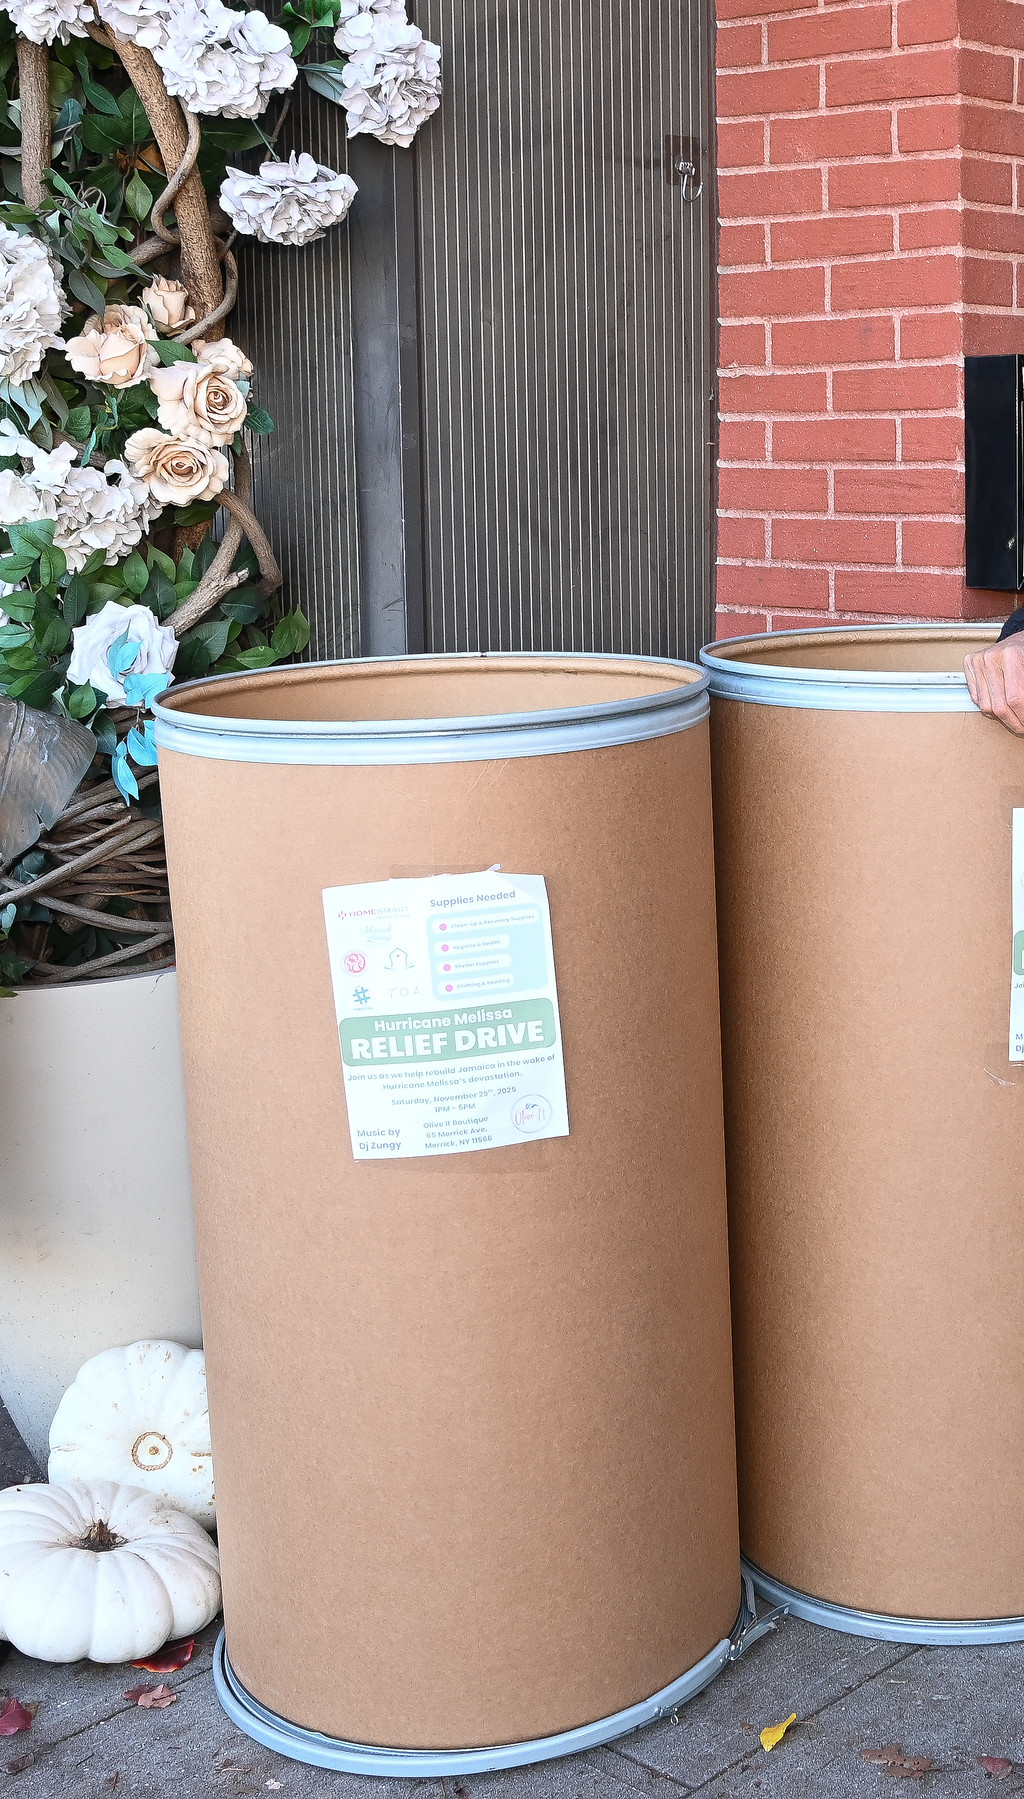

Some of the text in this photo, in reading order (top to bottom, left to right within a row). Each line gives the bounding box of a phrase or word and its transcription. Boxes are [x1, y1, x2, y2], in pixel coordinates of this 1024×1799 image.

[430, 890, 516, 908] Supplies Needed
[349, 906, 409, 917] HOMESMART
[374, 1008, 513, 1032] Hurricane Melissa
[350, 1020, 545, 1060] RELIEF DRIVE
[1015, 1044, 1024, 1053] Dj
[348, 1073, 366, 1081] Join
[405, 1070, 424, 1079] help
[425, 1067, 456, 1076] rebuild
[458, 1063, 496, 1073] Jamaica
[497, 1060, 505, 1068] in
[522, 1056, 545, 1064] wake
[382, 1070, 523, 1090] Hurricane Melissa's devastation.
[391, 1097, 432, 1106] Saturday,
[433, 1092, 477, 1102] November
[497, 1086, 517, 1095] 2025
[423, 1121, 444, 1129] Olive
[452, 1116, 488, 1126] Boutique
[357, 1128, 401, 1138] Music by
[438, 1129, 468, 1138] Merrick
[359, 1142, 402, 1152] Dj Zungy
[424, 1140, 458, 1149] Merrick,
[472, 1135, 493, 1144] 11566
